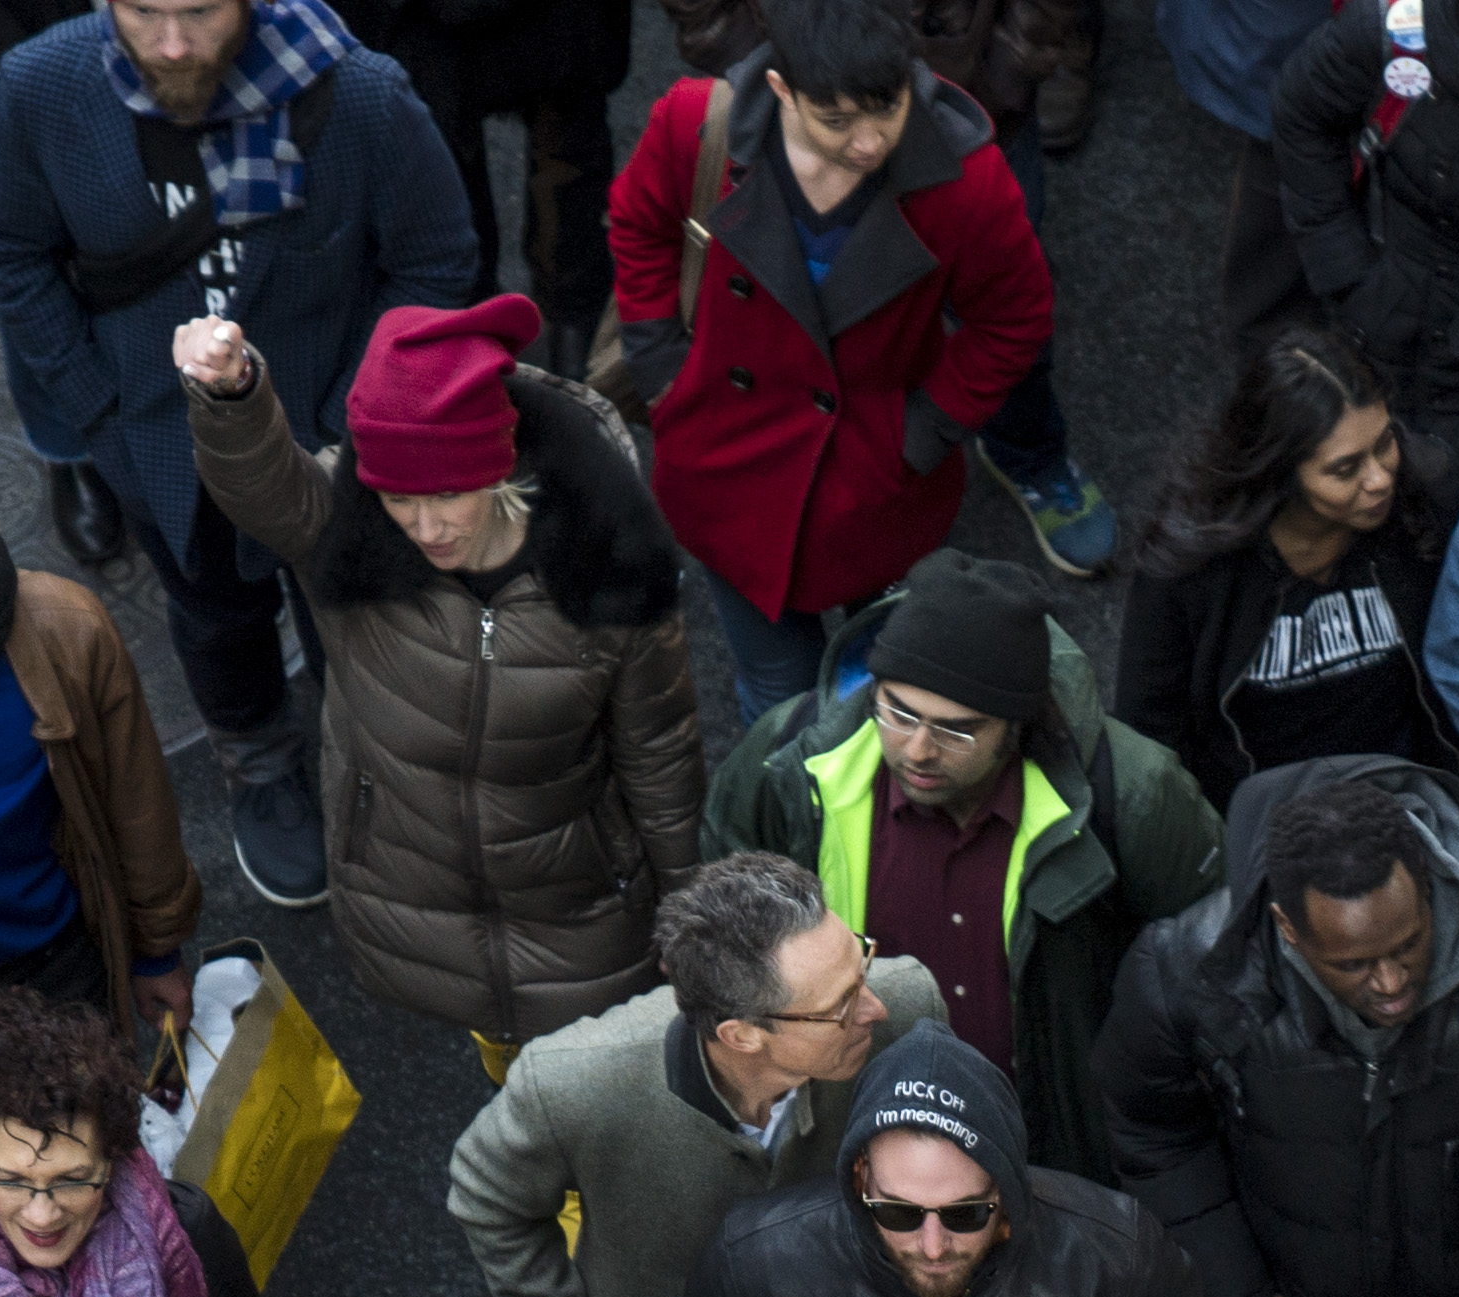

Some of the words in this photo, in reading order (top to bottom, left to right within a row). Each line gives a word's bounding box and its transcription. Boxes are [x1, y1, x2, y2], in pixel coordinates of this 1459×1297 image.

[894, 1080, 935, 1101] FUCK
[939, 1089, 966, 1112] OFF
[900, 1108, 978, 1149] meditating
